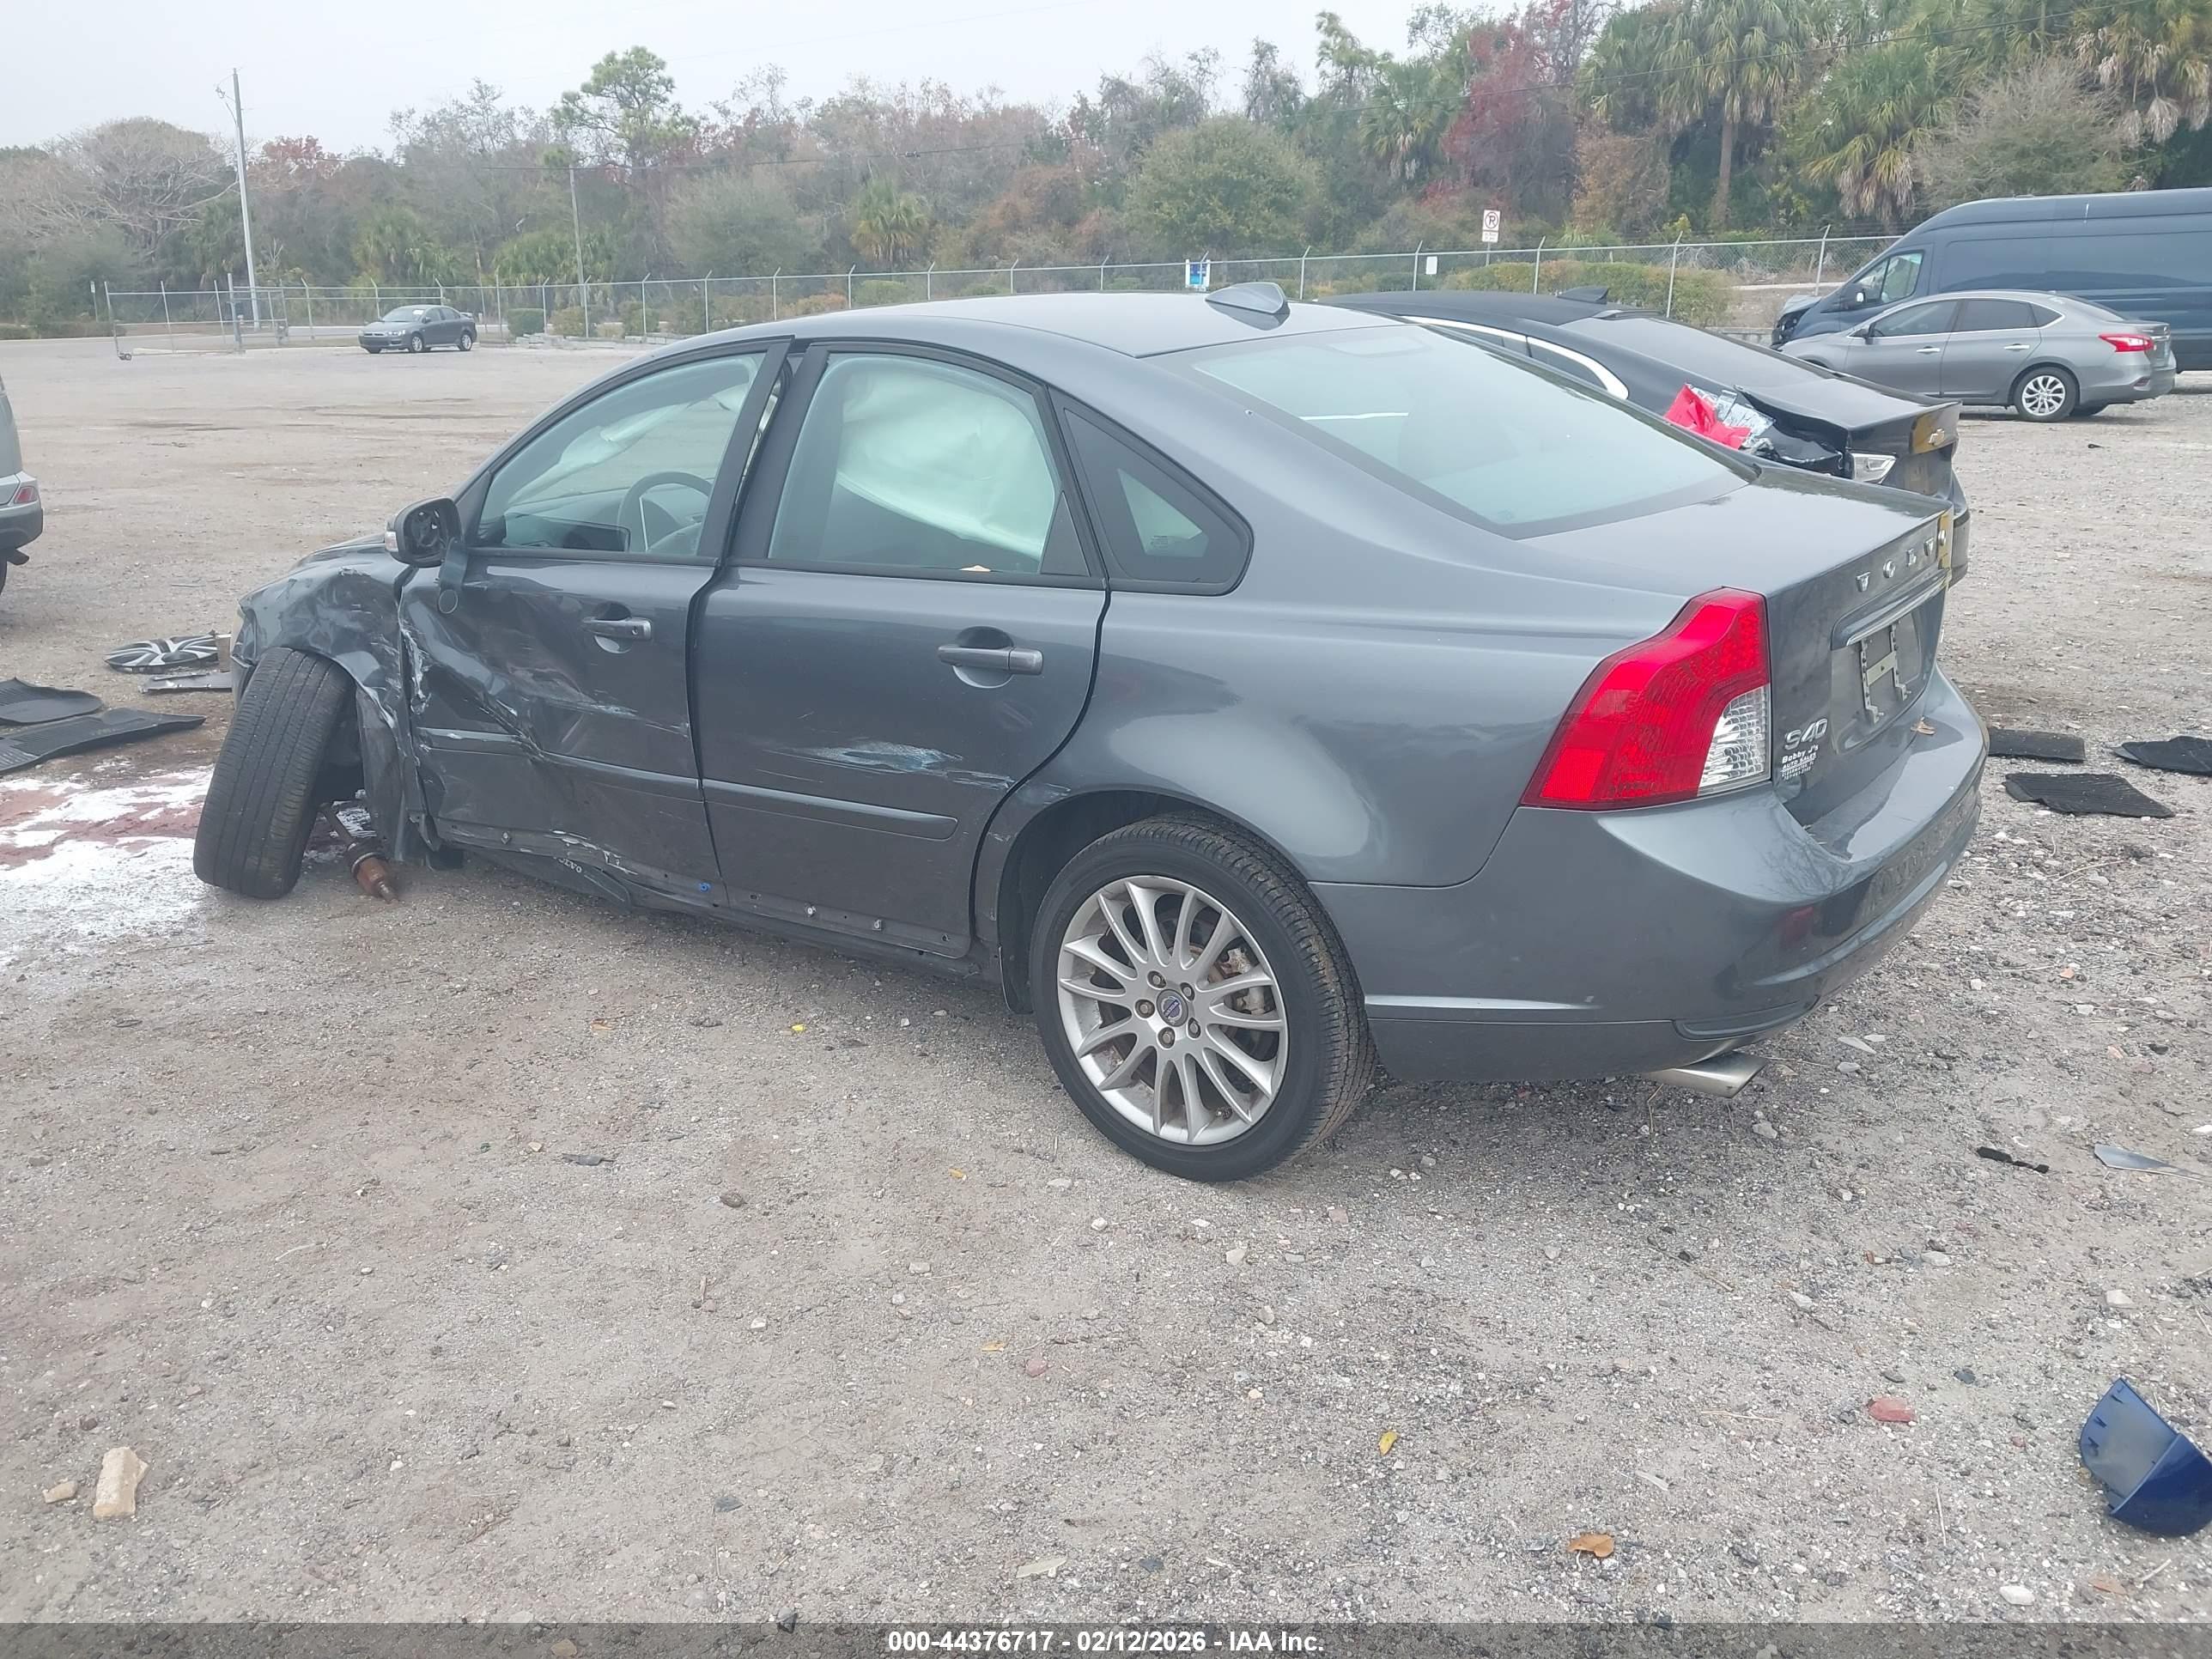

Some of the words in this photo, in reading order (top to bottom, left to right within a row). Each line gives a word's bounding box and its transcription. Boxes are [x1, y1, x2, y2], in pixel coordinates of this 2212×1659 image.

[1855, 529, 1947, 592] VOLVO
[1784, 718, 1827, 750] S40
[1782, 750, 1806, 764] Bobby
[1783, 759, 1798, 769] AUTO
